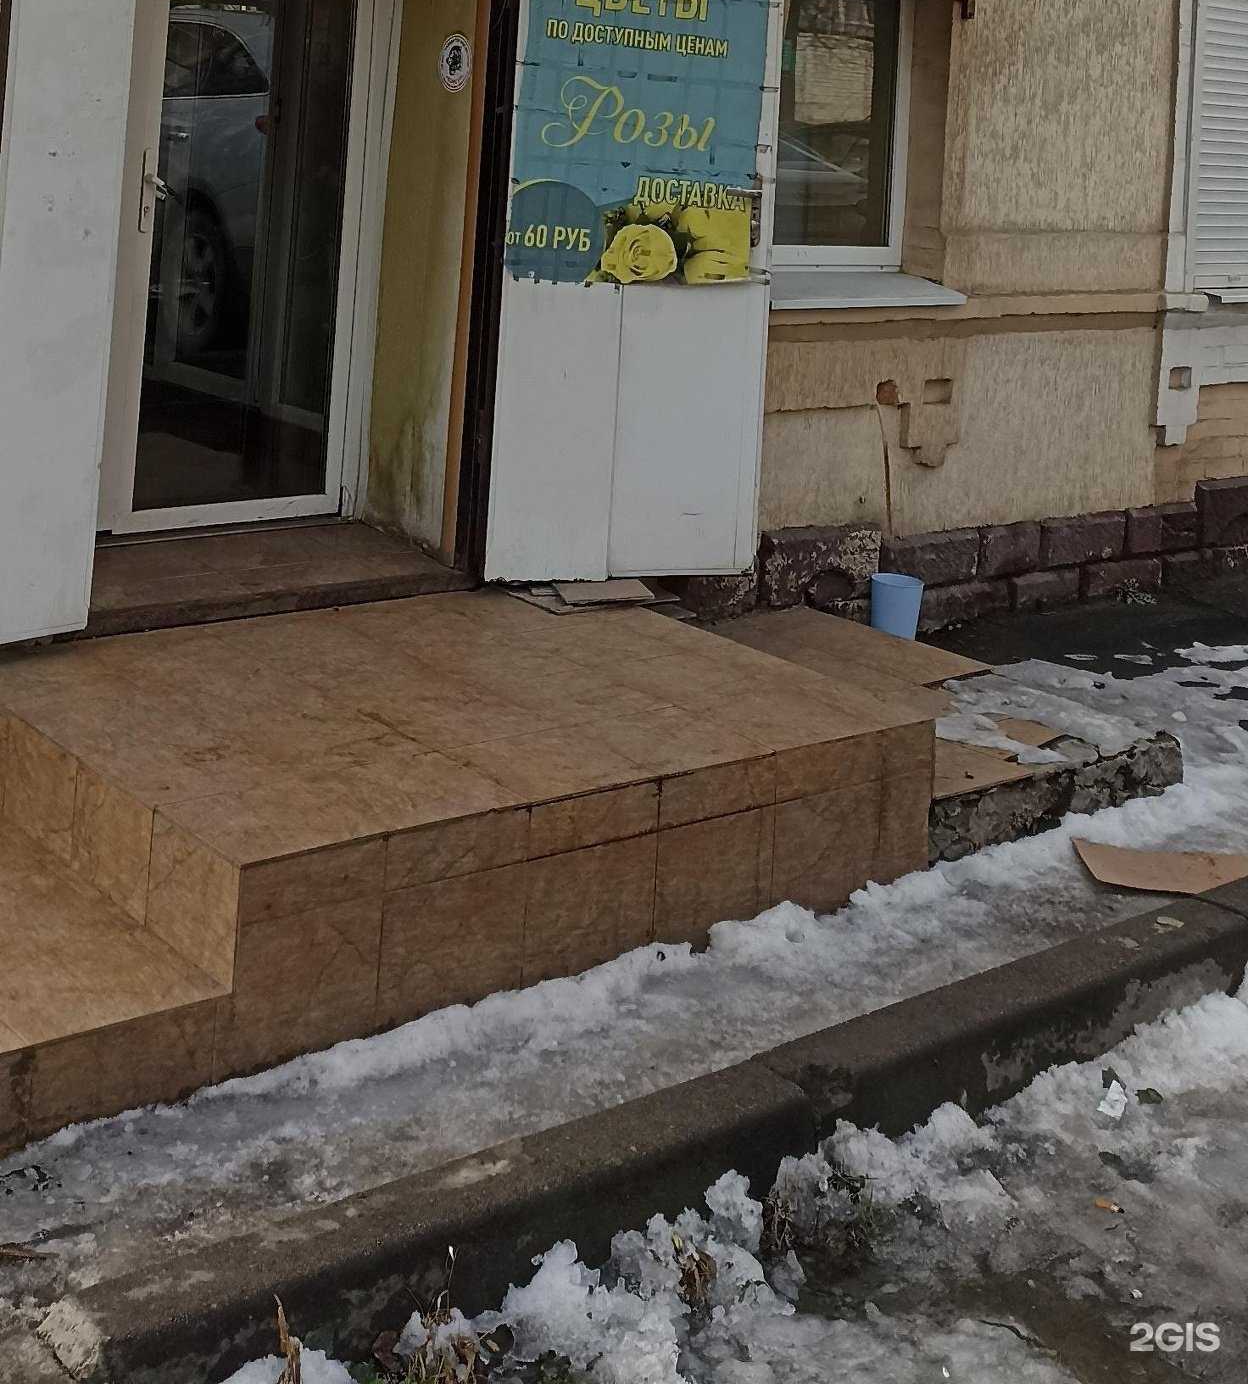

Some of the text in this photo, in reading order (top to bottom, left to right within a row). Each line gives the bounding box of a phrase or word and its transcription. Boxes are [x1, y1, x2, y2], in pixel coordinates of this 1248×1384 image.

[546, 18, 729, 58] ПО ДОСТУПНЫМ ЦЕНАМ
[541, 75, 716, 152] Розы
[524, 224, 548, 248] 60
[553, 227, 592, 252] РУБ
